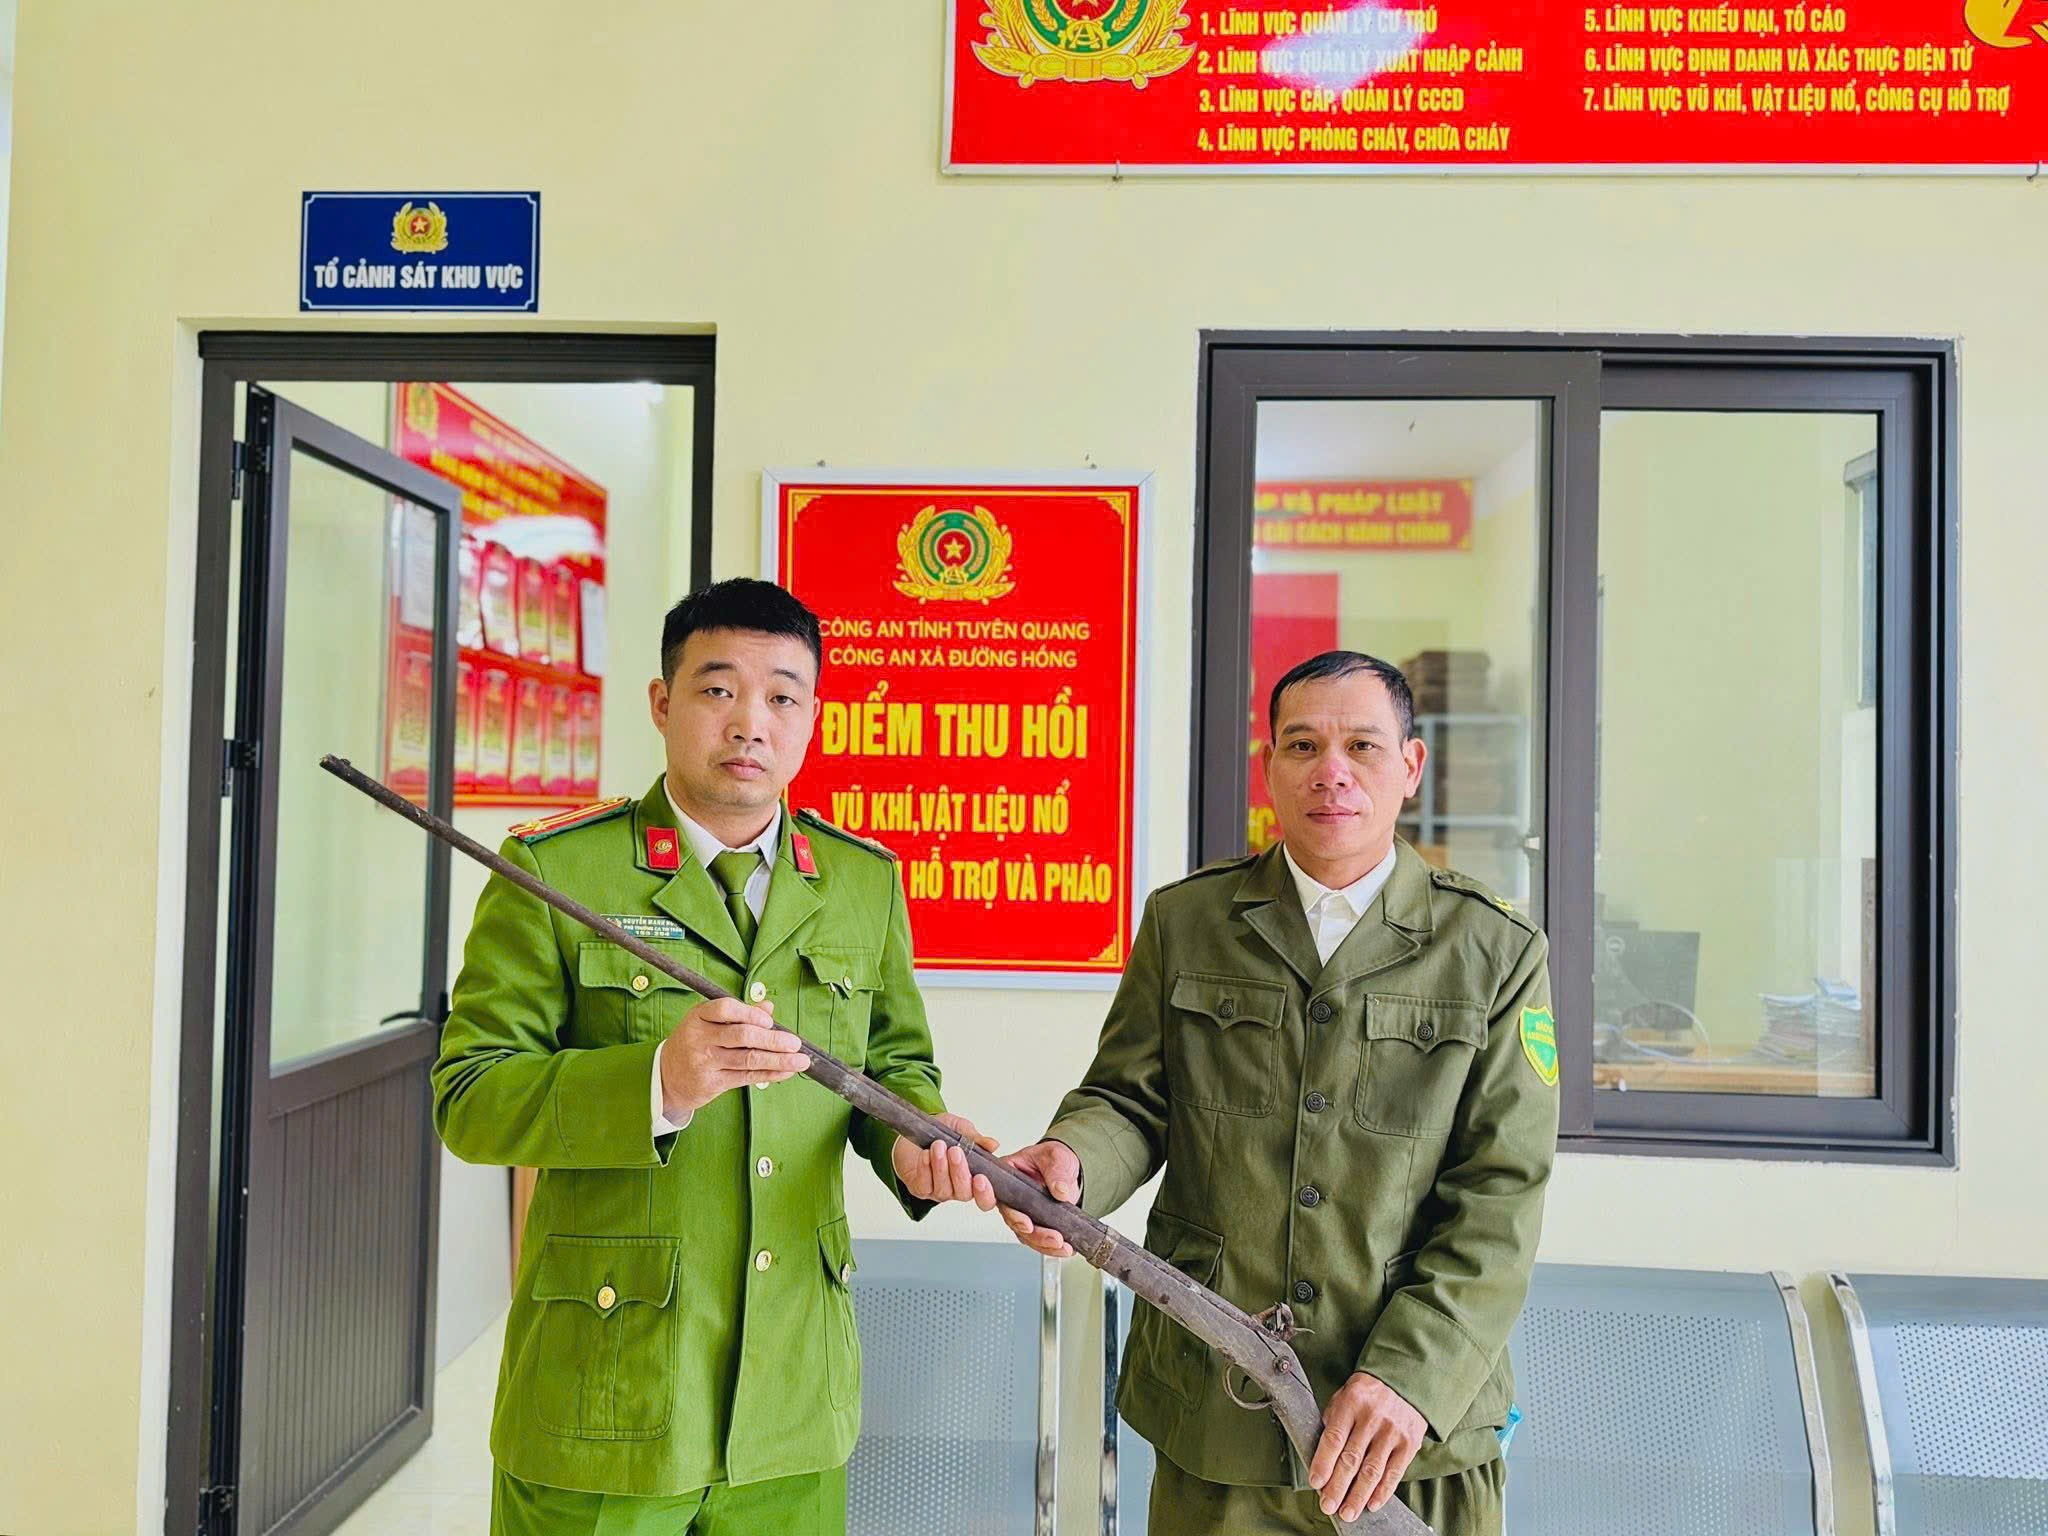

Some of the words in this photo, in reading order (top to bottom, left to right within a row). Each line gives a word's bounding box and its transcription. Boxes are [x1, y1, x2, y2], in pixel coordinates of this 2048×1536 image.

[1200, 12, 1216, 35] 1.
[1220, 8, 1259, 35] LĨNH
[1263, 9, 1296, 40] VỰC
[1301, 4, 1347, 36] QUẢN
[1404, 5, 1437, 33] TRÚ
[1584, 8, 1600, 32] 5.
[1605, 4, 1645, 32] LĨNH
[1650, 6, 1683, 37] VỰC
[1688, 1, 1739, 32] KHIẾU
[1744, 8, 1779, 38] NẠI,
[1784, 1, 1806, 32] TỐ
[1810, 3, 1846, 32] CÁO
[1198, 51, 1213, 74] 2.
[1218, 46, 1257, 74] LĨNH
[1261, 49, 1293, 78] VỰC
[1423, 43, 1471, 77] NHẬP
[1475, 40, 1523, 72] CẢNH
[1584, 47, 1600, 72] 6.
[1605, 43, 1645, 72] LĨNH
[1650, 45, 1683, 77] VỰC
[1688, 47, 1730, 77] ĐỊNH
[1735, 47, 1782, 72] DANH
[1787, 43, 1810, 72] VÀ
[1814, 43, 1850, 72] XÁC
[1854, 45, 1899, 77] THỰC
[1904, 42, 1946, 77] ĐIỆN
[1950, 40, 1975, 72] TỬ
[1199, 89, 1215, 112] 3.
[1219, 84, 1258, 112] LĨNH
[1263, 87, 1296, 117] VỰC
[1342, 81, 1389, 114] QUẢN
[1393, 83, 1413, 112] LÝ
[1418, 87, 1464, 112] CCCD
[1583, 87, 1599, 112] 7.
[1604, 83, 1643, 112] LĨNH
[1648, 86, 1682, 117] VỰC
[1686, 83, 1709, 112] VŨ
[1713, 82, 1747, 114] KHÍ,
[1752, 83, 1784, 117] VẬT
[1788, 83, 1826, 117] LIỆU
[1831, 78, 1861, 116] NỔ,
[1866, 82, 1914, 112] CÔNG
[1919, 86, 1942, 117] CỤ
[1947, 79, 1971, 112] HỖ
[1976, 85, 2010, 117] TRỢ
[1197, 128, 1214, 151] 4.
[1218, 123, 1257, 151] LĨNH
[1261, 125, 1295, 156] VỰC
[1300, 121, 1358, 151] PHÒNG
[1362, 122, 1409, 155] CHÁY,
[1414, 123, 1461, 151] CHỮA
[1465, 122, 1510, 151] CHÁY
[314, 256, 339, 288] TỔ
[343, 257, 396, 288] CẢNH
[400, 260, 437, 289] SÁT
[441, 265, 480, 289] KHU
[485, 263, 523, 293] VỰC
[819, 616, 872, 638] CÔNG
[876, 620, 904, 638] AN
[956, 617, 1018, 639] TUYÊN
[1021, 621, 1090, 640] QUANG
[829, 643, 885, 666] CÔNG
[888, 647, 916, 666] AN
[920, 645, 945, 667] XÃ
[949, 645, 1017, 667] ĐƯỜNG
[821, 679, 922, 756] ĐIỂM
[934, 704, 1010, 758] THU
[1021, 685, 1088, 759] HỒI
[831, 784, 864, 831] VŨ
[972, 785, 1026, 842] LIỆU
[1032, 778, 1070, 834] NỔ
[909, 846, 944, 900] HỖ
[951, 857, 1000, 910] TRỢ
[1004, 853, 1038, 901] VÀ
[1044, 854, 1113, 904] PHÁO
